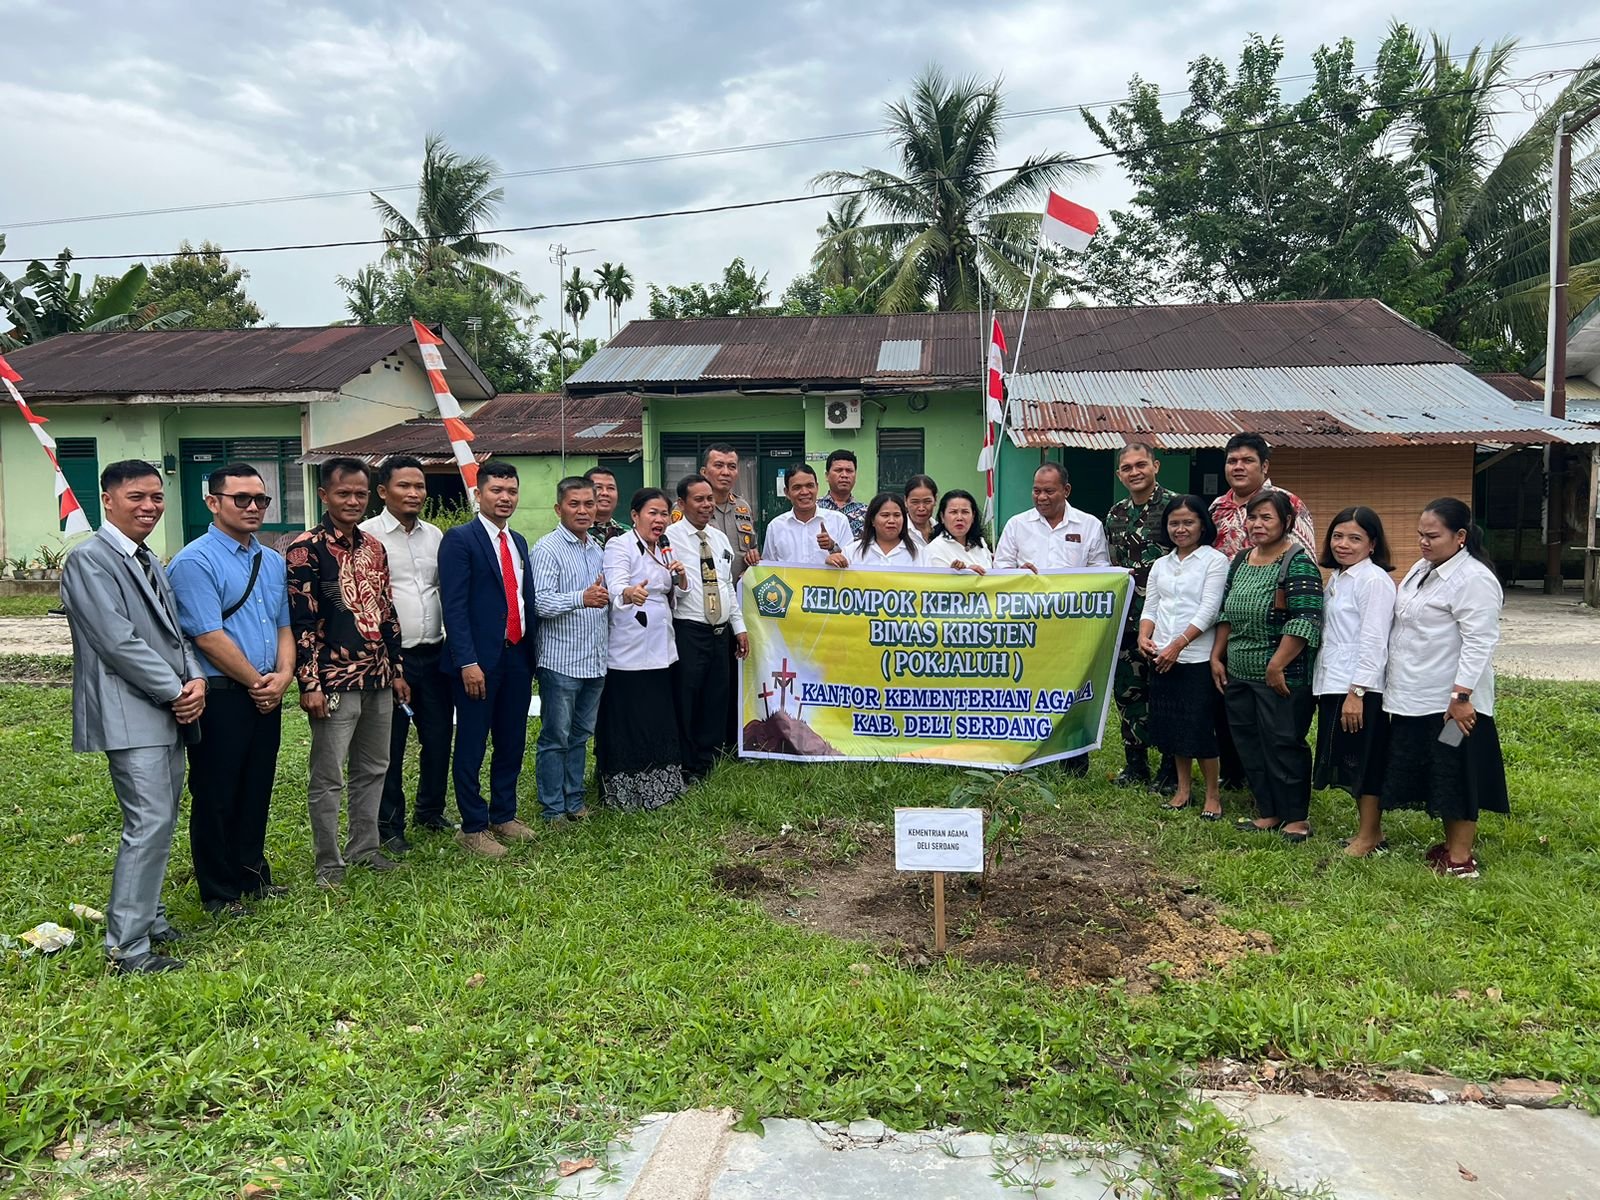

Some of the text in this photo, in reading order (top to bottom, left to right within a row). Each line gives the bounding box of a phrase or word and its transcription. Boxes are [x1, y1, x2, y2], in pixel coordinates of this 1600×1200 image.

[801, 585, 1115, 618] KELOMPOK KERJA PENYULUH
[869, 619, 1037, 648] BIMAS KRISTEN
[800, 680, 1094, 713] KANTOR KEMENTERIAN AGAA
[853, 712, 1053, 740] KAB. DELI SERDANG
[908, 829, 969, 838] KEMENTRIAN AGAMA
[917, 842, 960, 851] DELI SERDANG
